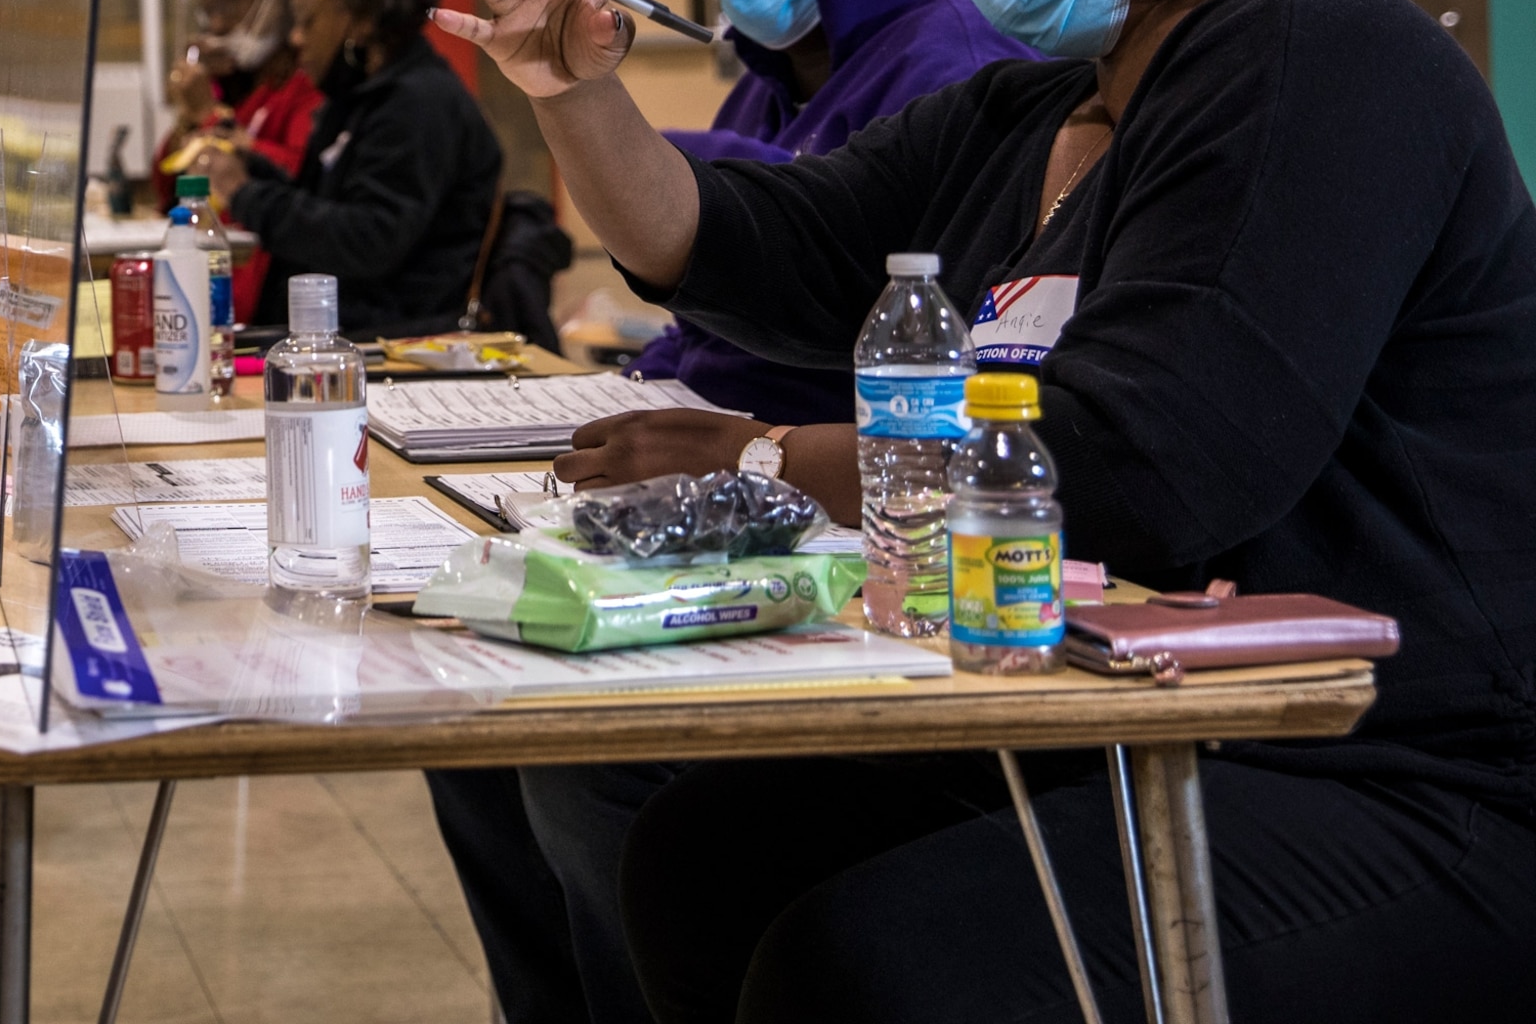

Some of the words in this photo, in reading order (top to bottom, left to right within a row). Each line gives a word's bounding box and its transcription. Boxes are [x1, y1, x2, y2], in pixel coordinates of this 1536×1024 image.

[995, 310, 1045, 333] Angie
[975, 347, 1008, 361] CTION
[994, 549, 1050, 563] MOTT'S
[998, 574, 1025, 584] 100%
[670, 610, 718, 626] ALCOHOL
[719, 608, 751, 621] WIPES
